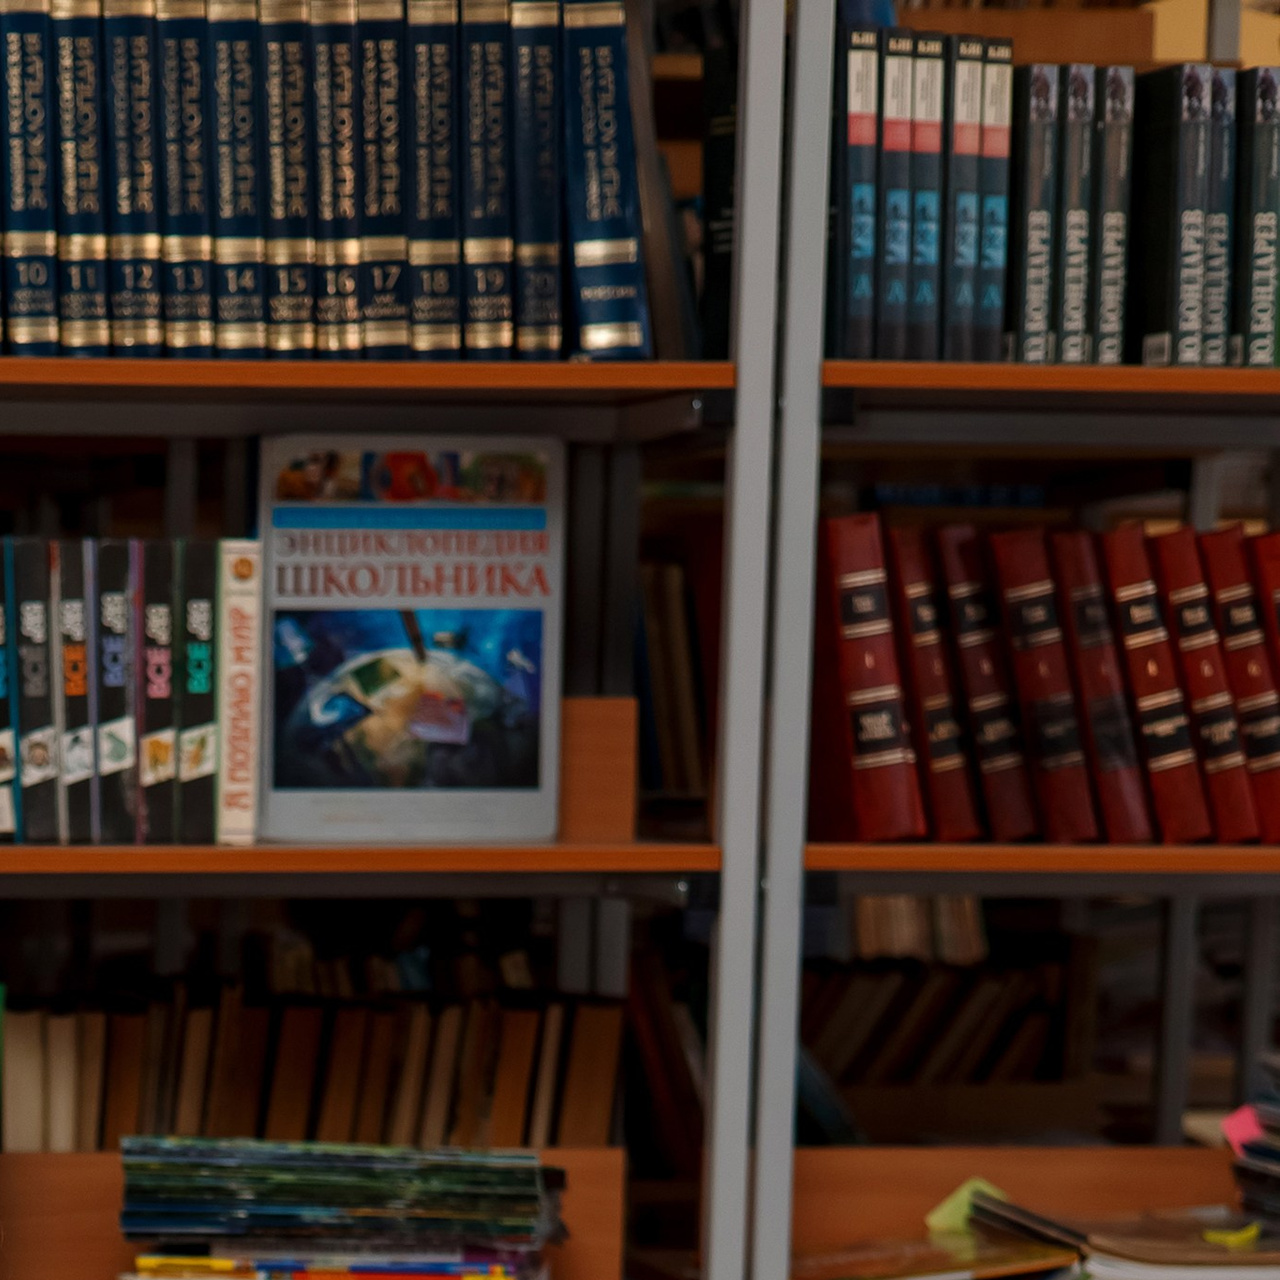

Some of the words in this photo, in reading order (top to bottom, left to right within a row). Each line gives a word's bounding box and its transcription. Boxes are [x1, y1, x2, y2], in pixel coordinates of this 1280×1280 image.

[24, 33, 47, 210] ЭНЦИКЛОПЕДИЯ
[76, 36, 99, 213] ЭНЦИКЛОПЕДИЯ
[129, 35, 152, 213] ЭНЦИКЛОПЕДИЯ
[181, 38, 204, 215] ЭНЦИКЛОПЕДИЯ
[233, 40, 256, 216] ЭНЦИКЛОПЕДИЯ
[284, 41, 307, 218] ЭНЦИКЛОПЕДИЯ
[333, 42, 355, 219] ЭНЦИКЛОПЕДИЯ
[379, 39, 401, 215] ЭНЦИКЛОПЕДИЯ
[432, 43, 452, 218] ЭНЦИКЛОПЕДИЯ
[486, 42, 504, 218] ЭНЦИКЛОПЕДИЯ
[595, 45, 621, 219] ЭНЦИКЛОПЕДИЯ
[16, 262, 48, 286] 10
[67, 265, 96, 290] 11
[122, 264, 153, 289] 12
[172, 266, 203, 291] 13
[226, 267, 255, 293] 14
[276, 269, 306, 293] 15
[324, 271, 356, 294] 16
[372, 267, 402, 291] 17
[421, 271, 449, 293] 18
[474, 269, 504, 293] 19
[1024, 210, 1050, 332] БОНДАРЕВ
[1064, 210, 1090, 330] БОНДАРЕВ
[1100, 211, 1125, 332] БОНДАРЕВ
[1179, 208, 1204, 330] БОНДАРЕВ
[1204, 213, 1228, 333] БОНДАРЕВ
[1250, 211, 1276, 332] БОНДАРЕВ
[275, 531, 550, 558] ЭНЦИКЛОПЕДИЯ
[276, 562, 551, 597] ШКОЛЬНИКА
[229, 607, 252, 665] МИР
[225, 673, 250, 783] ПОЗНАЮ
[224, 792, 250, 810] Я
